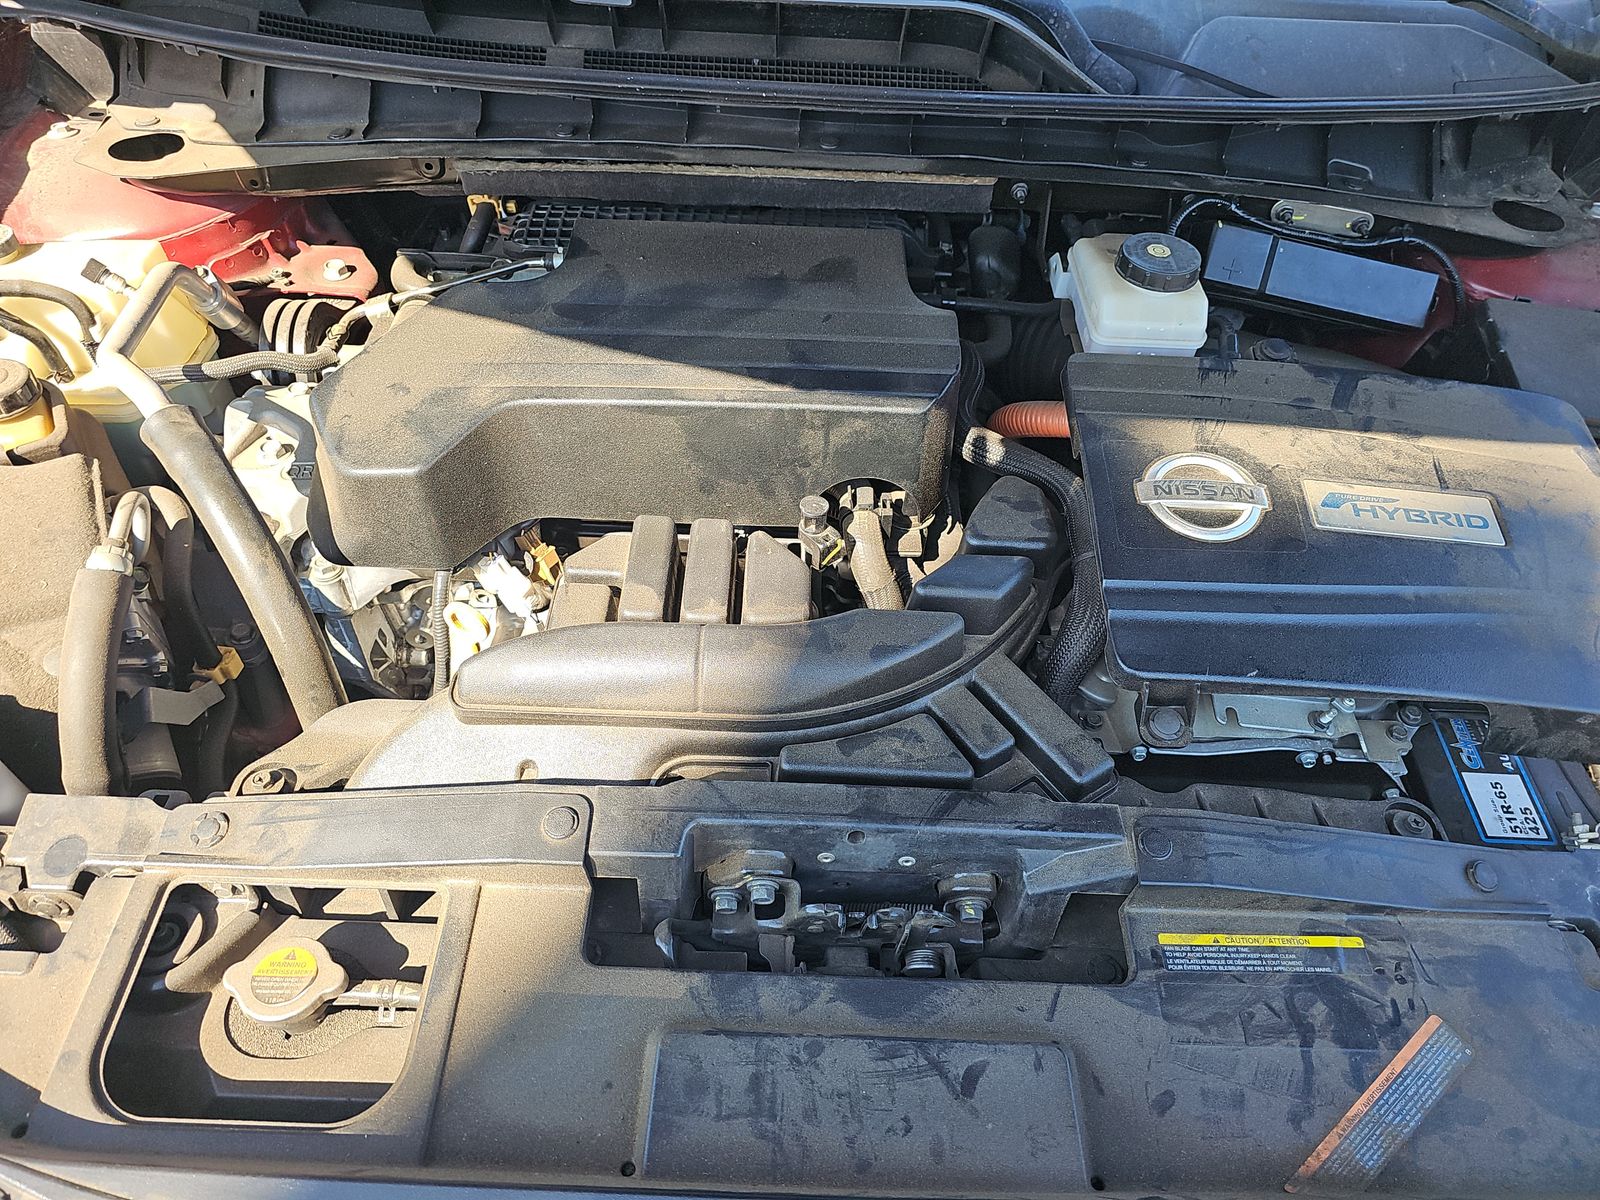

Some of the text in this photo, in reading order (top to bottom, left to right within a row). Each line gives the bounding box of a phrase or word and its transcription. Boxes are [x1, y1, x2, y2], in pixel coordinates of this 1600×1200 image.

[1152, 484, 1255, 500] NISSAN
[1351, 502, 1490, 530] HYBRID
[1490, 781, 1522, 834] 51R-65
[1519, 807, 1541, 836] 425
